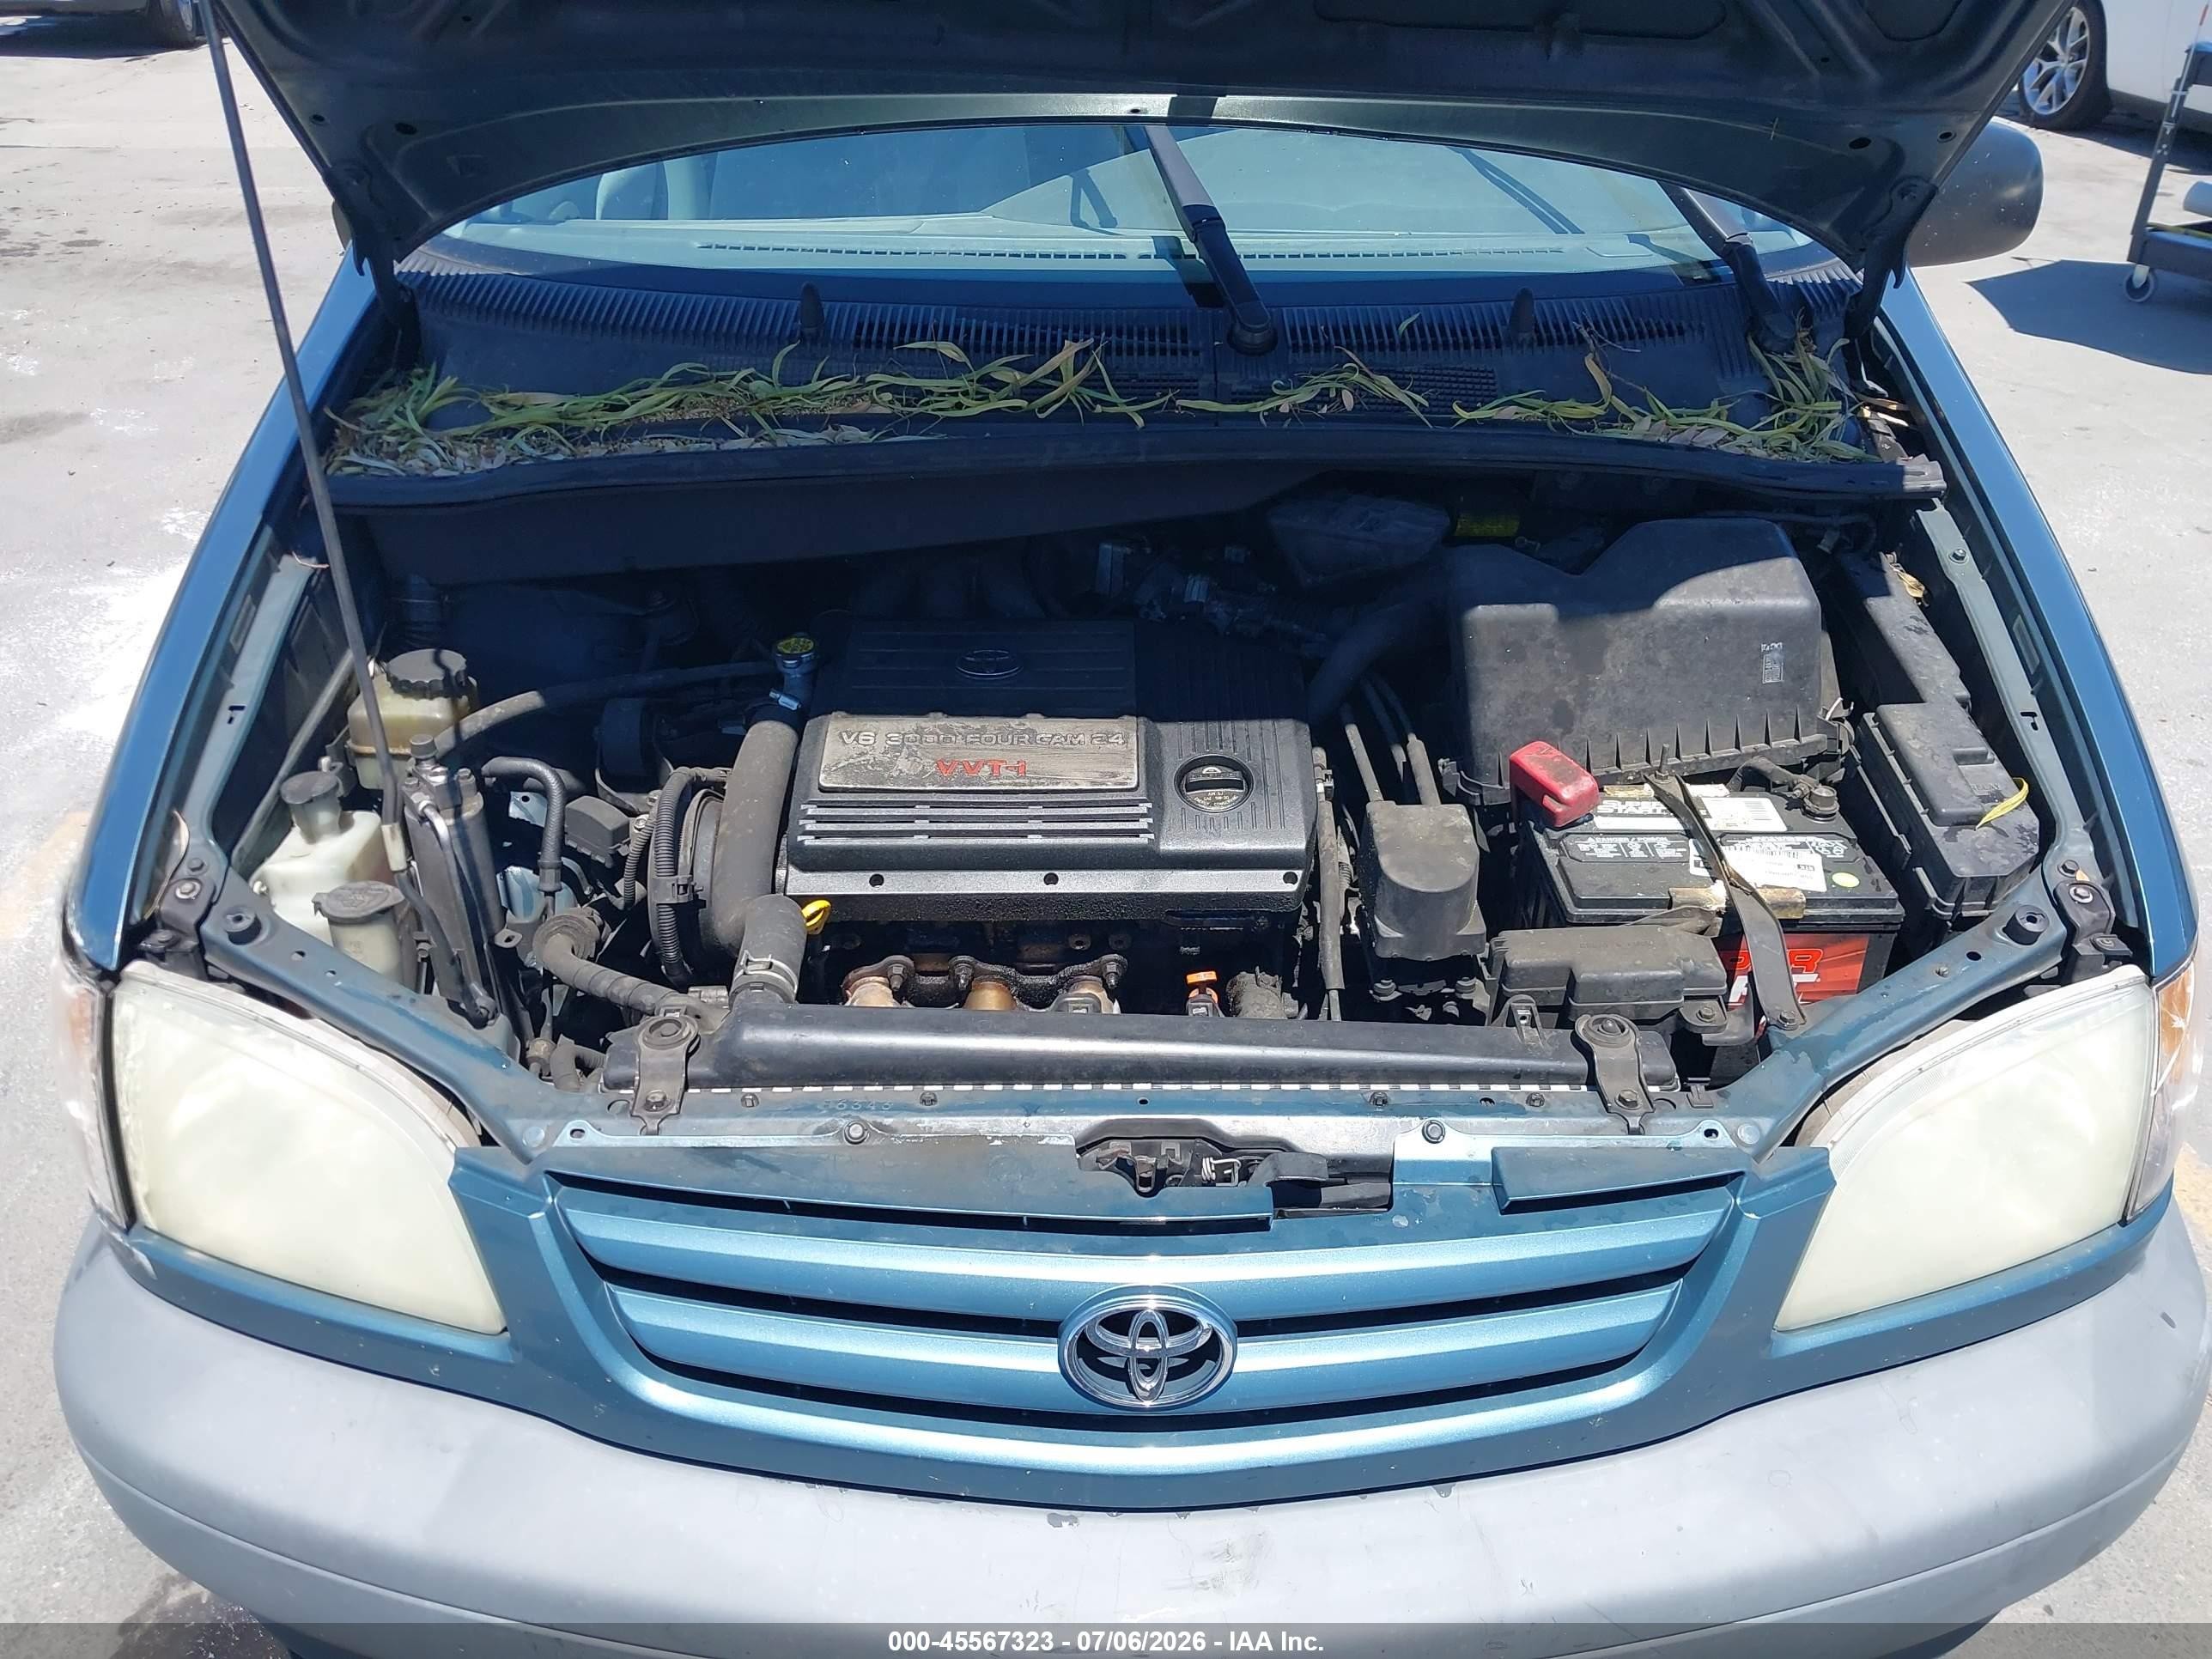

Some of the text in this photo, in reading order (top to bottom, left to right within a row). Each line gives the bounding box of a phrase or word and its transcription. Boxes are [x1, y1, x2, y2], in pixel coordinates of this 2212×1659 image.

[841, 731, 1127, 746] V6 3000 FOUR CAM 24
